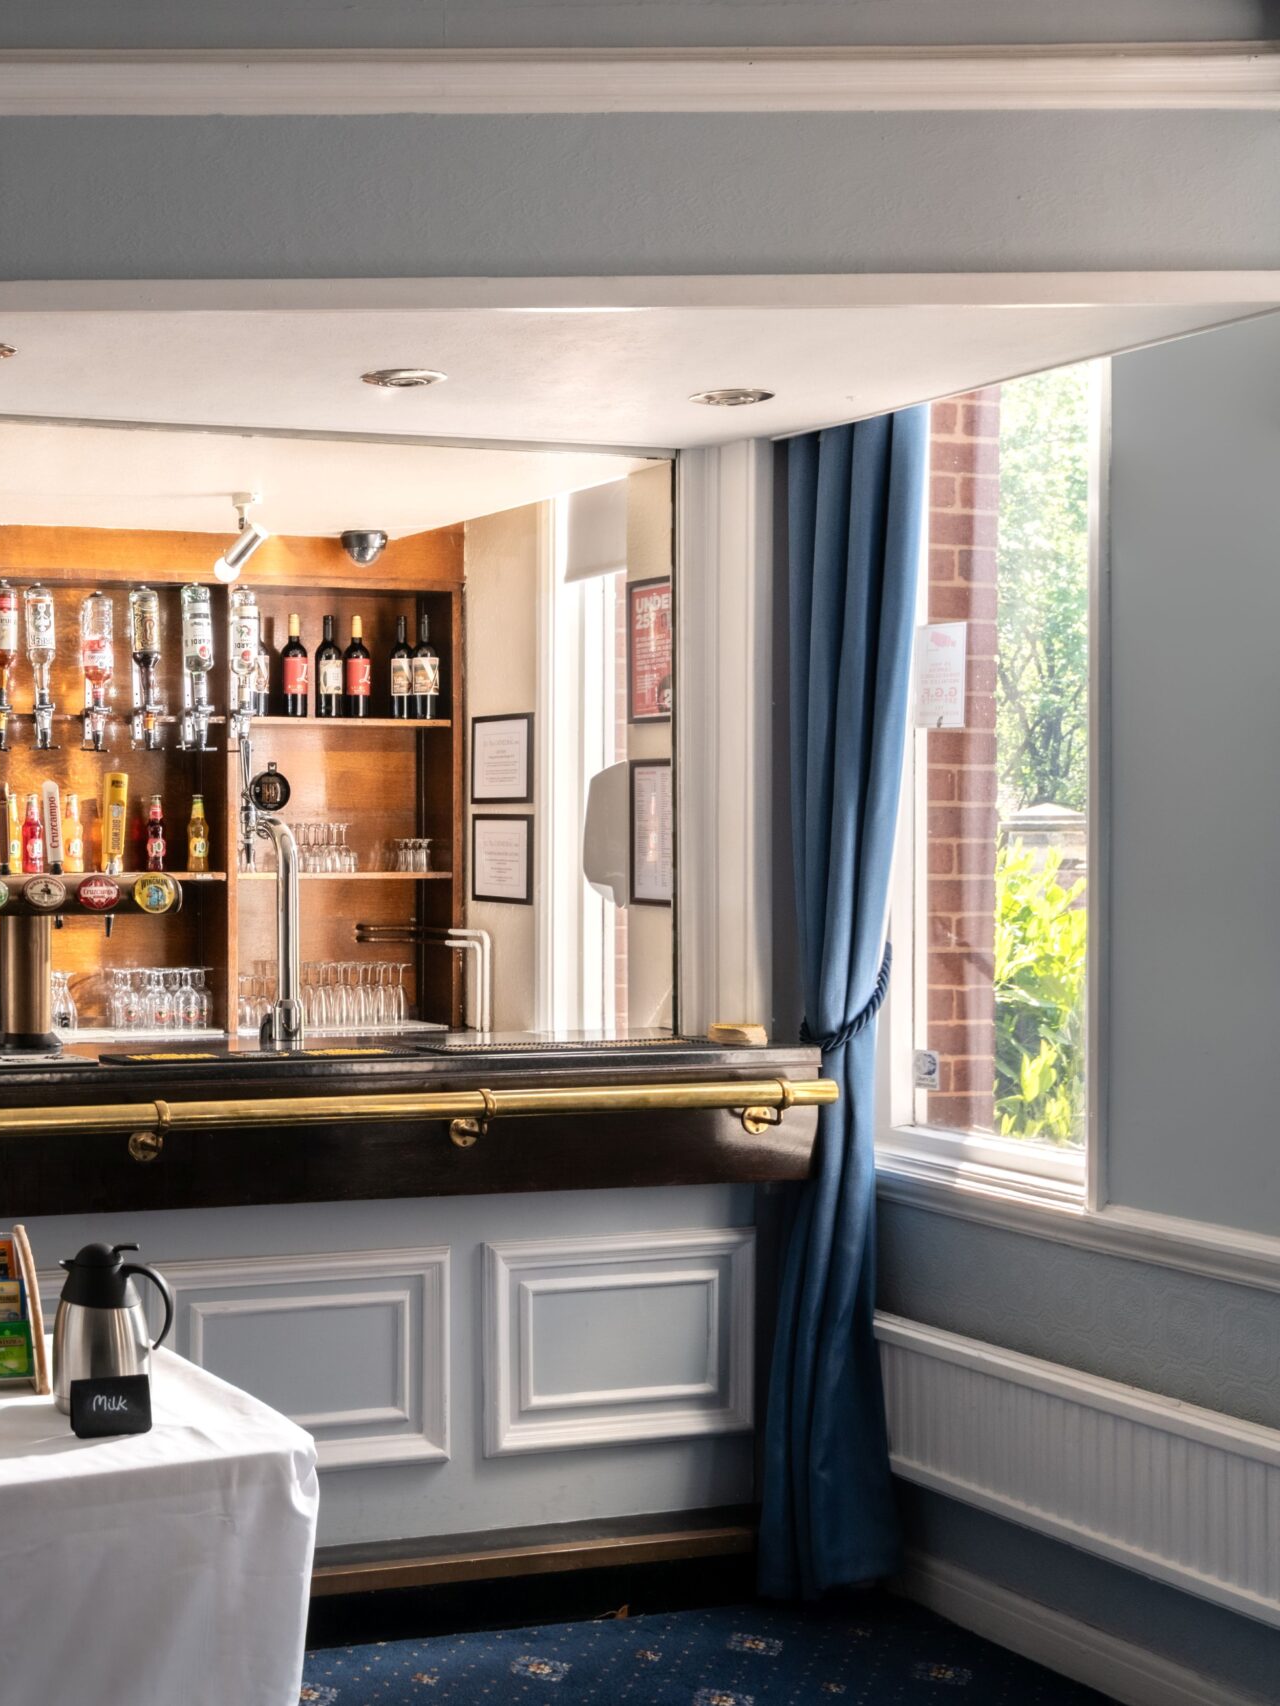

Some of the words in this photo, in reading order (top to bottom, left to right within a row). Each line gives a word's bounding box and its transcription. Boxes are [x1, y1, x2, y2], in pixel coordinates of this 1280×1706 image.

[635, 593, 671, 614] UNDE
[48, 796, 59, 849] Cruzcampo
[93, 1395, 128, 1412] Milk
